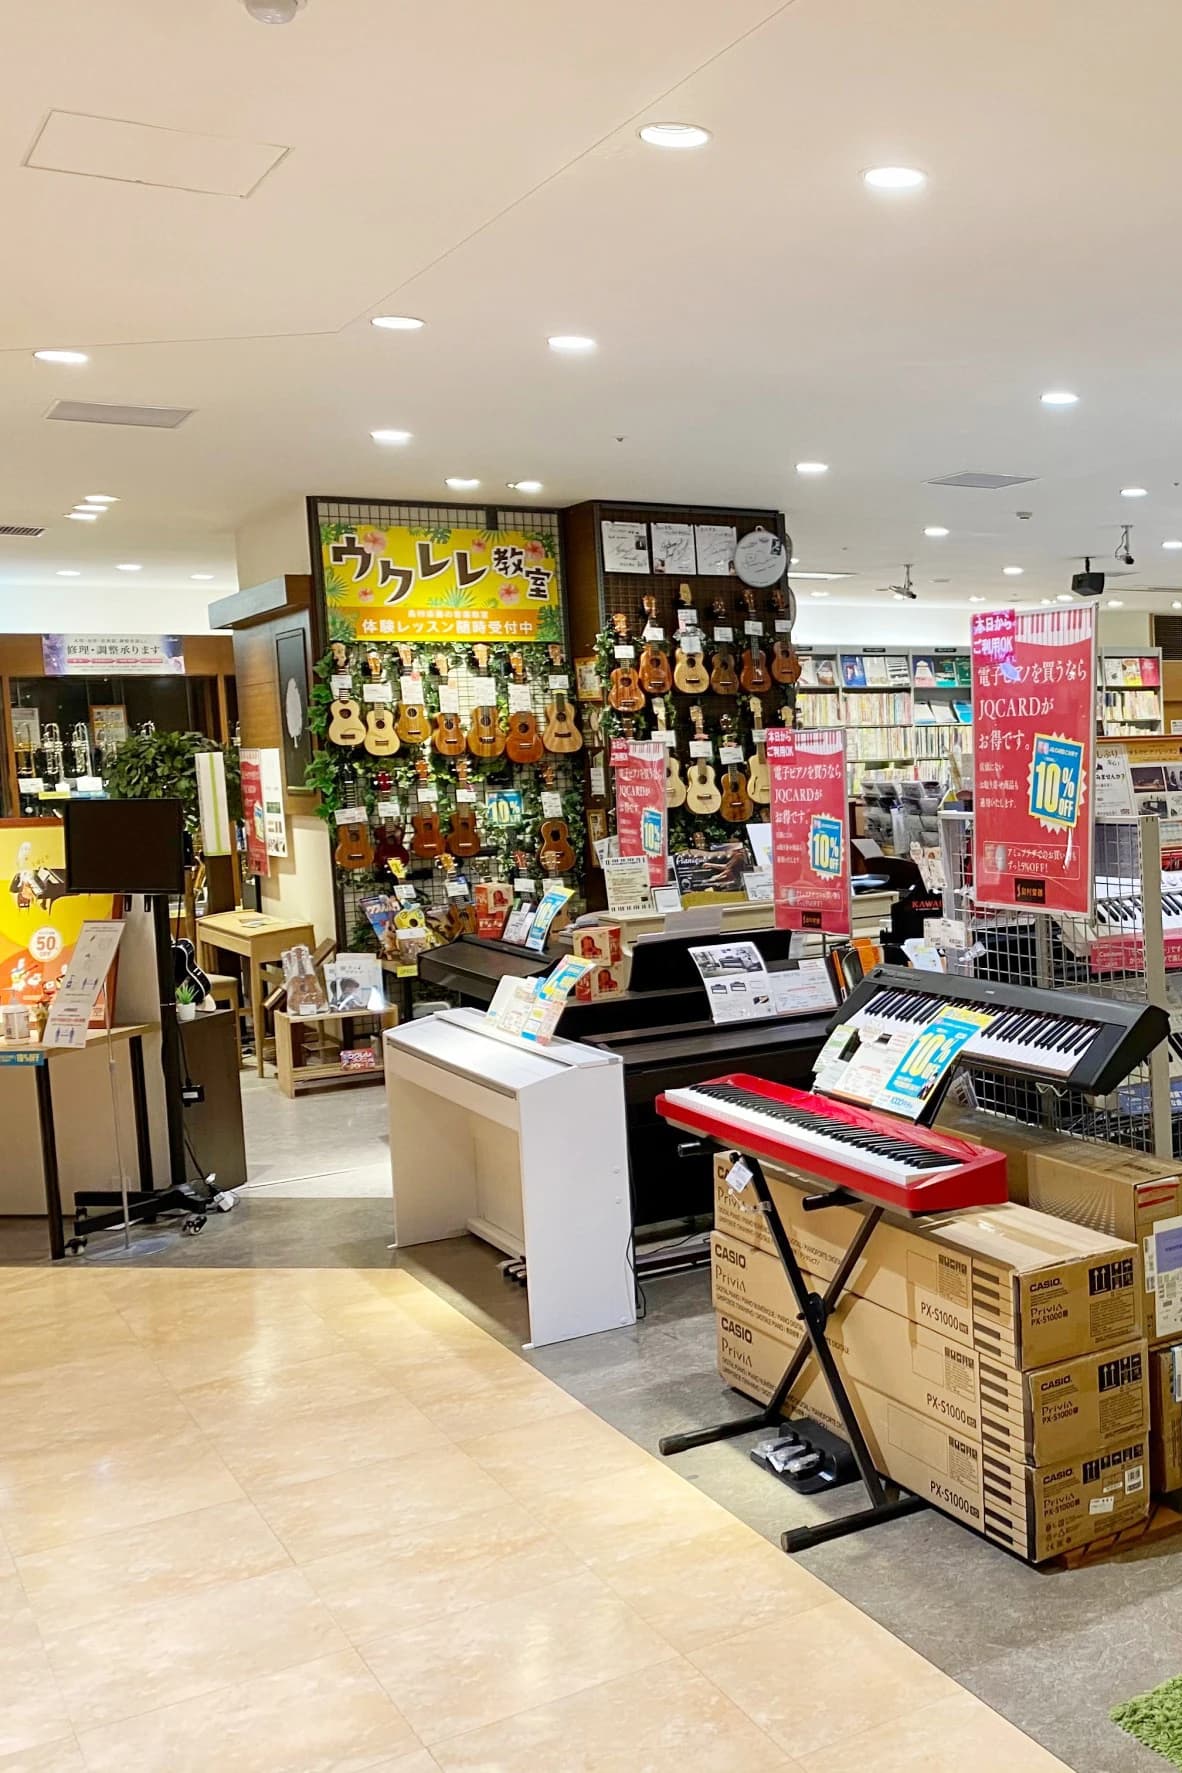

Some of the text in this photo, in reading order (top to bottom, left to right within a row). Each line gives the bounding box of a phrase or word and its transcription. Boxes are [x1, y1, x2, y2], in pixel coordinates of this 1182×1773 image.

[331, 535, 553, 604] ウクレレ教室
[362, 619, 533, 635] 体験レッスン随時受付中
[67, 645, 160, 655] 修理・調整承ります
[978, 697, 1054, 720] JQCARDが
[979, 730, 1030, 750] お得です。
[775, 788, 823, 803] JQCARDが
[1059, 798, 1074, 818] OFF
[714, 1243, 747, 1269] CASIO
[1029, 1278, 1061, 1293] CASIO
[921, 1301, 959, 1331] PX-S1000
[721, 1316, 753, 1344] CASIO
[1041, 1375, 1071, 1391] CASIO
[926, 1392, 967, 1424] PX-S1000
[1043, 1468, 1073, 1485] CASIO
[930, 1479, 970, 1514] PX-S1000
